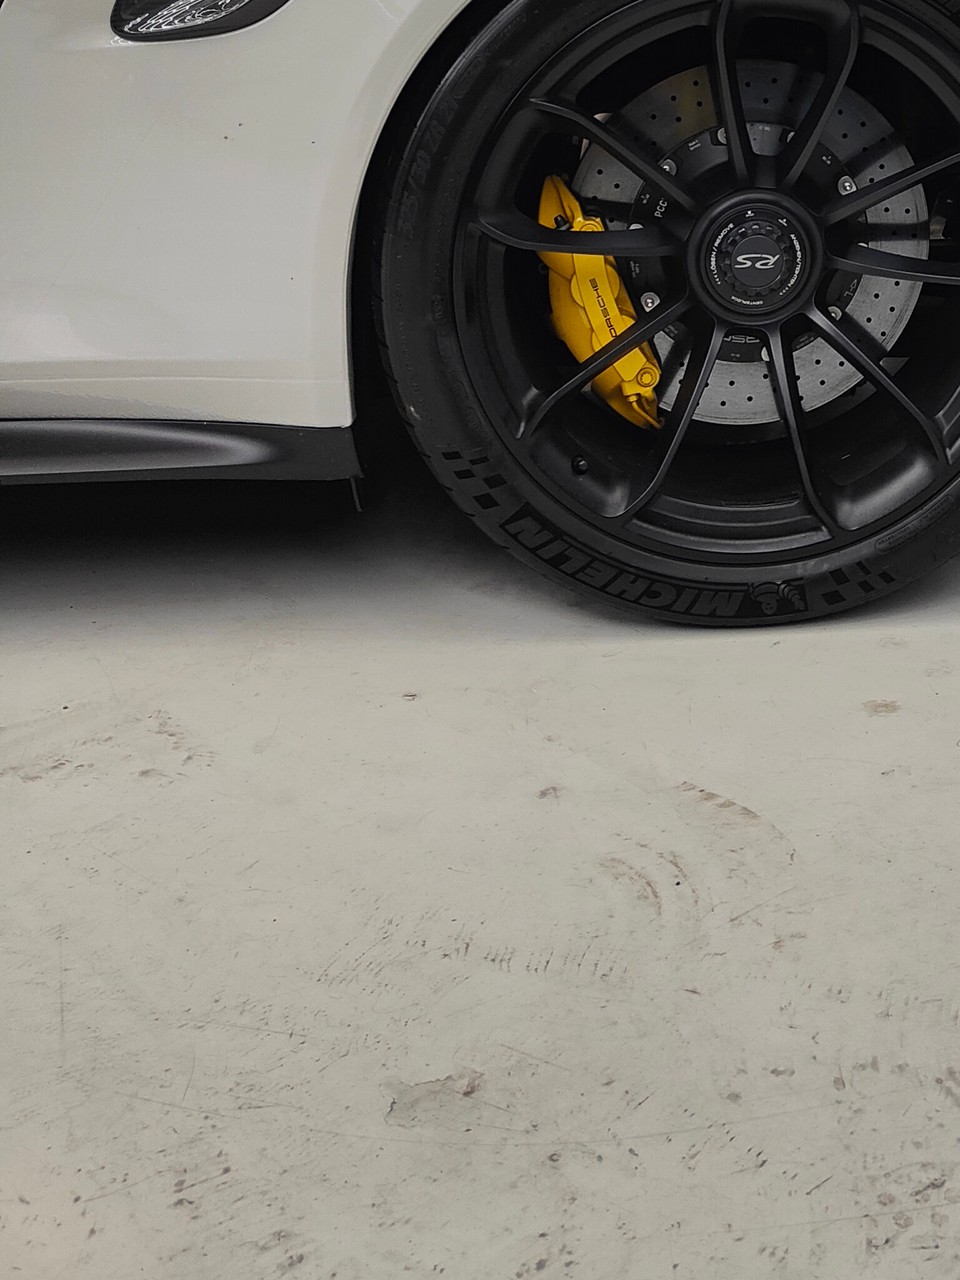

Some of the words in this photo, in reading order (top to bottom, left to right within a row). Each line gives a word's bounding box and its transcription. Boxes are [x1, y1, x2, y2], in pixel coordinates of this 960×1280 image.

[713, 223, 735, 248] REMOVE
[734, 253, 780, 269] RS
[589, 277, 618, 338] ORSCHE
[504, 516, 744, 617] MICHELIN
